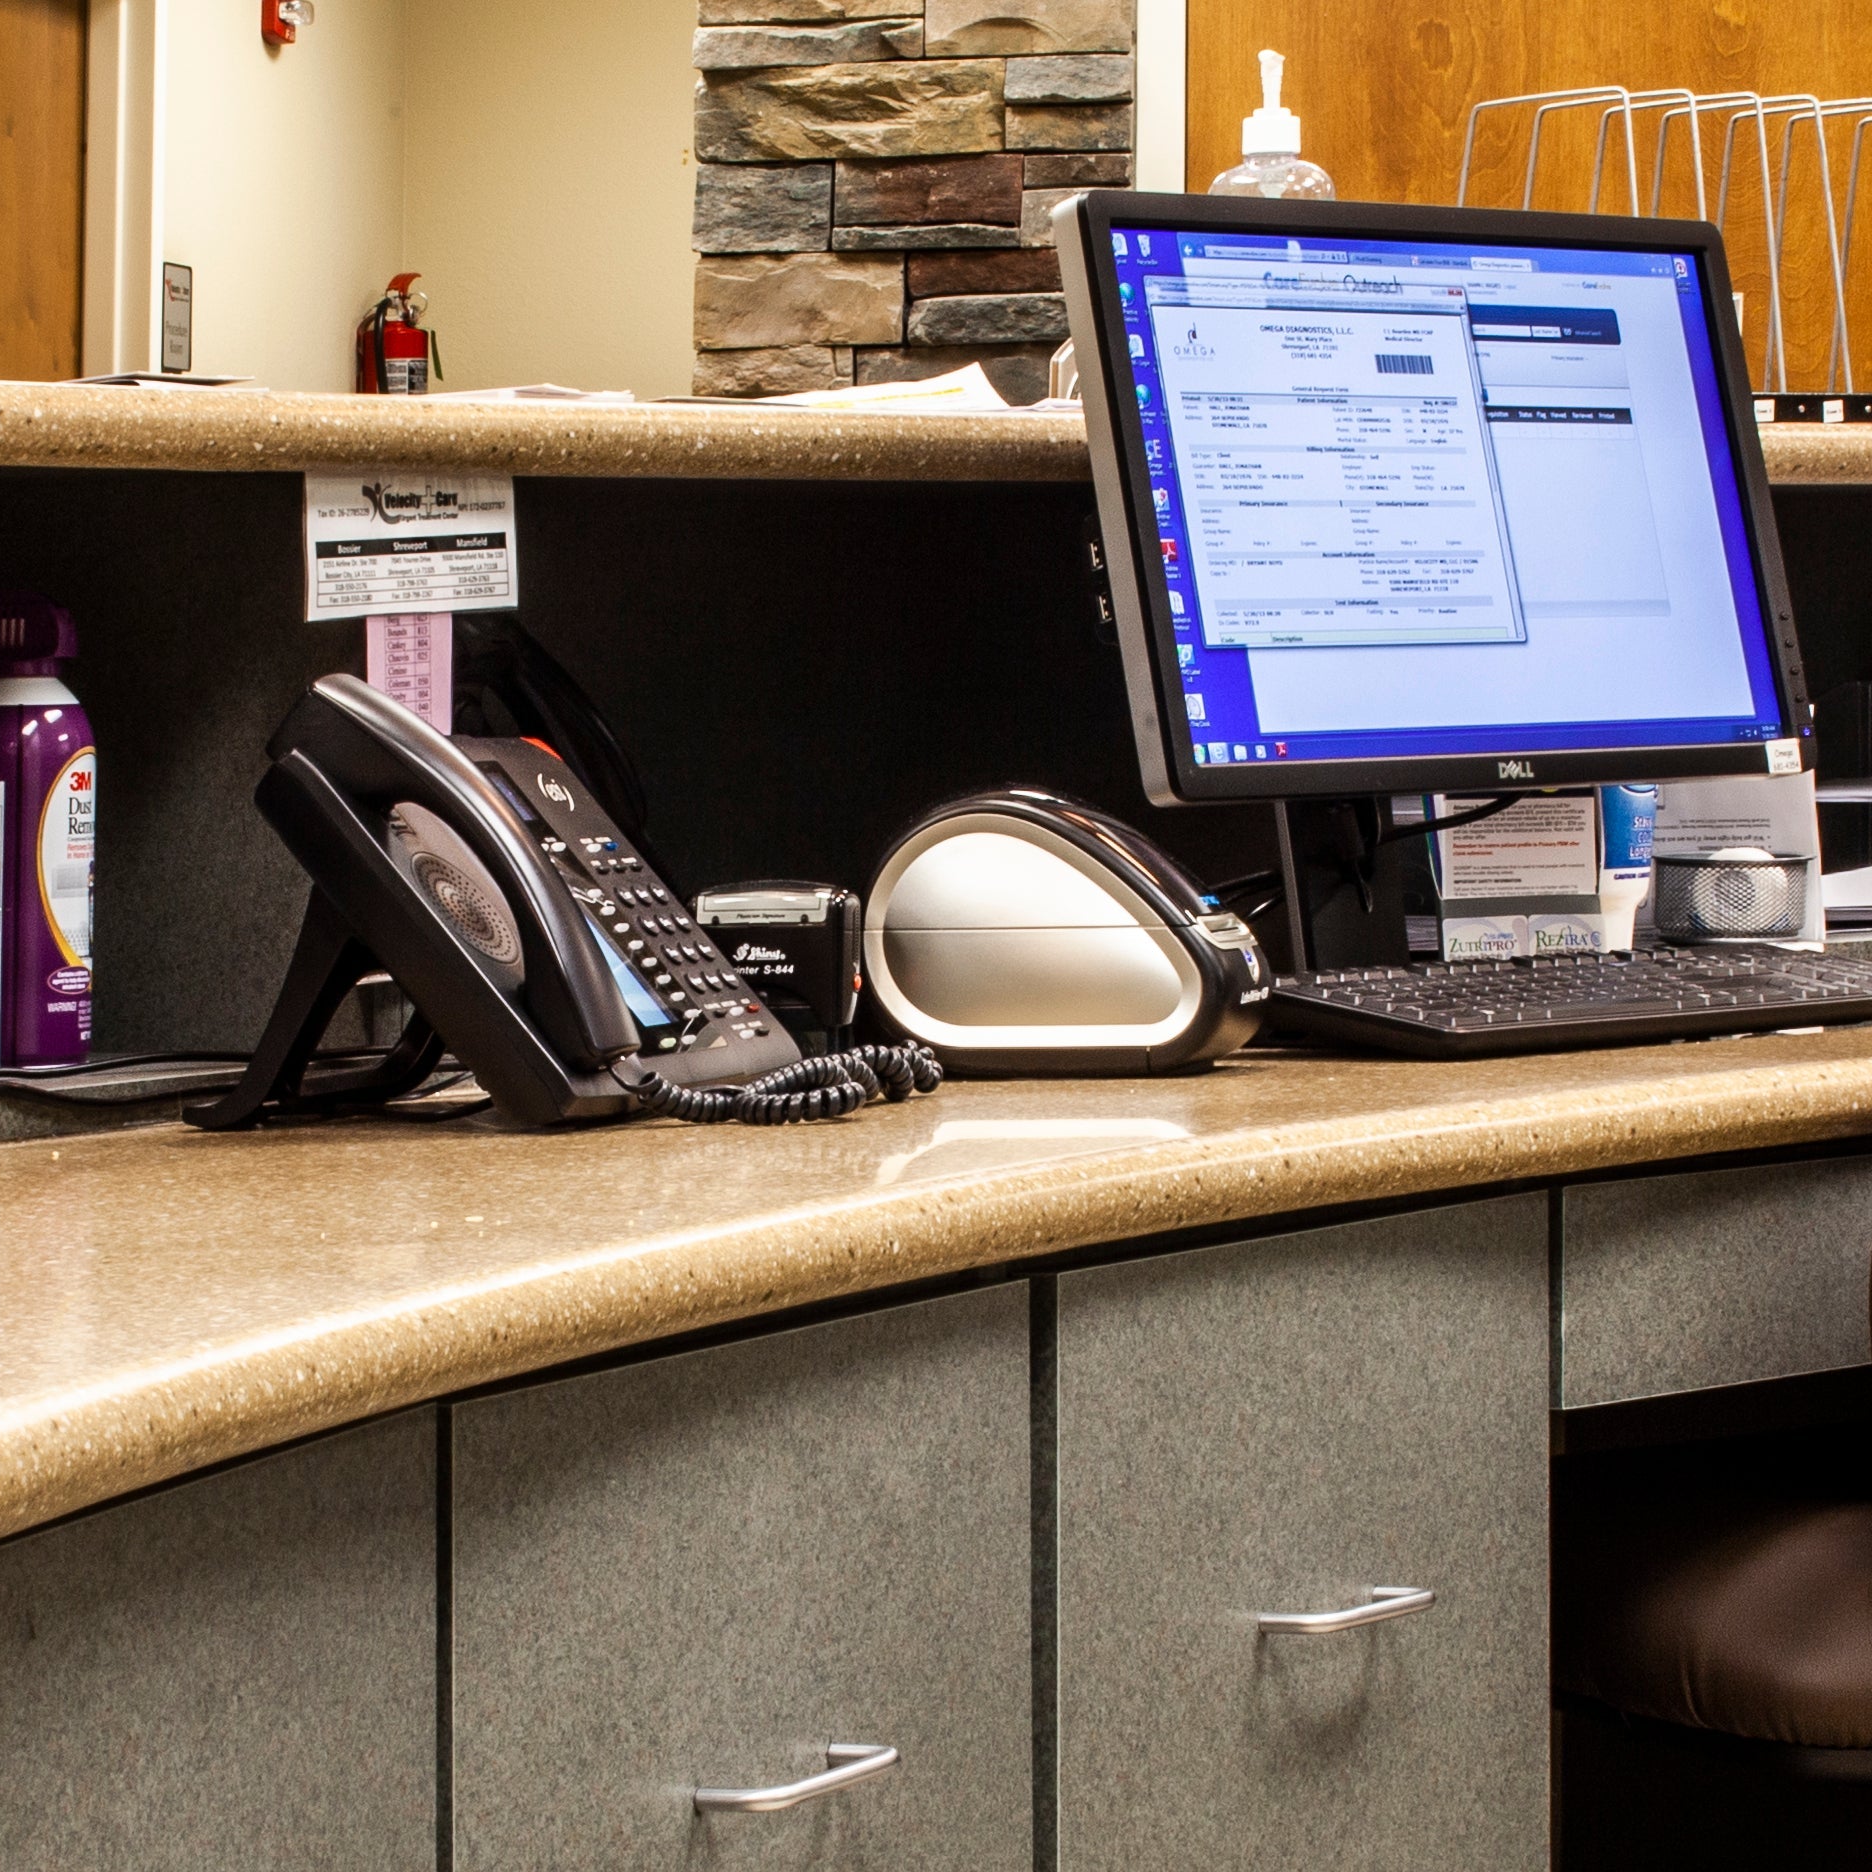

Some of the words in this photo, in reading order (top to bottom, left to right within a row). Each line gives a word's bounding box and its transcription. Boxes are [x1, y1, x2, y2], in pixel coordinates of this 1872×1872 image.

[1259, 323, 1283, 333] OMEGA
[1173, 345, 1216, 357] OMEGA
[384, 491, 423, 510] Velocity
[435, 490, 459, 507] Care
[318, 509, 328, 518] Tax
[393, 541, 428, 552] Shreveport
[456, 536, 488, 548] Mansfield
[337, 544, 362, 554] Bossier
[1498, 760, 1534, 780] DELL
[69, 771, 92, 791] 3M
[763, 964, 795, 975] S-844
